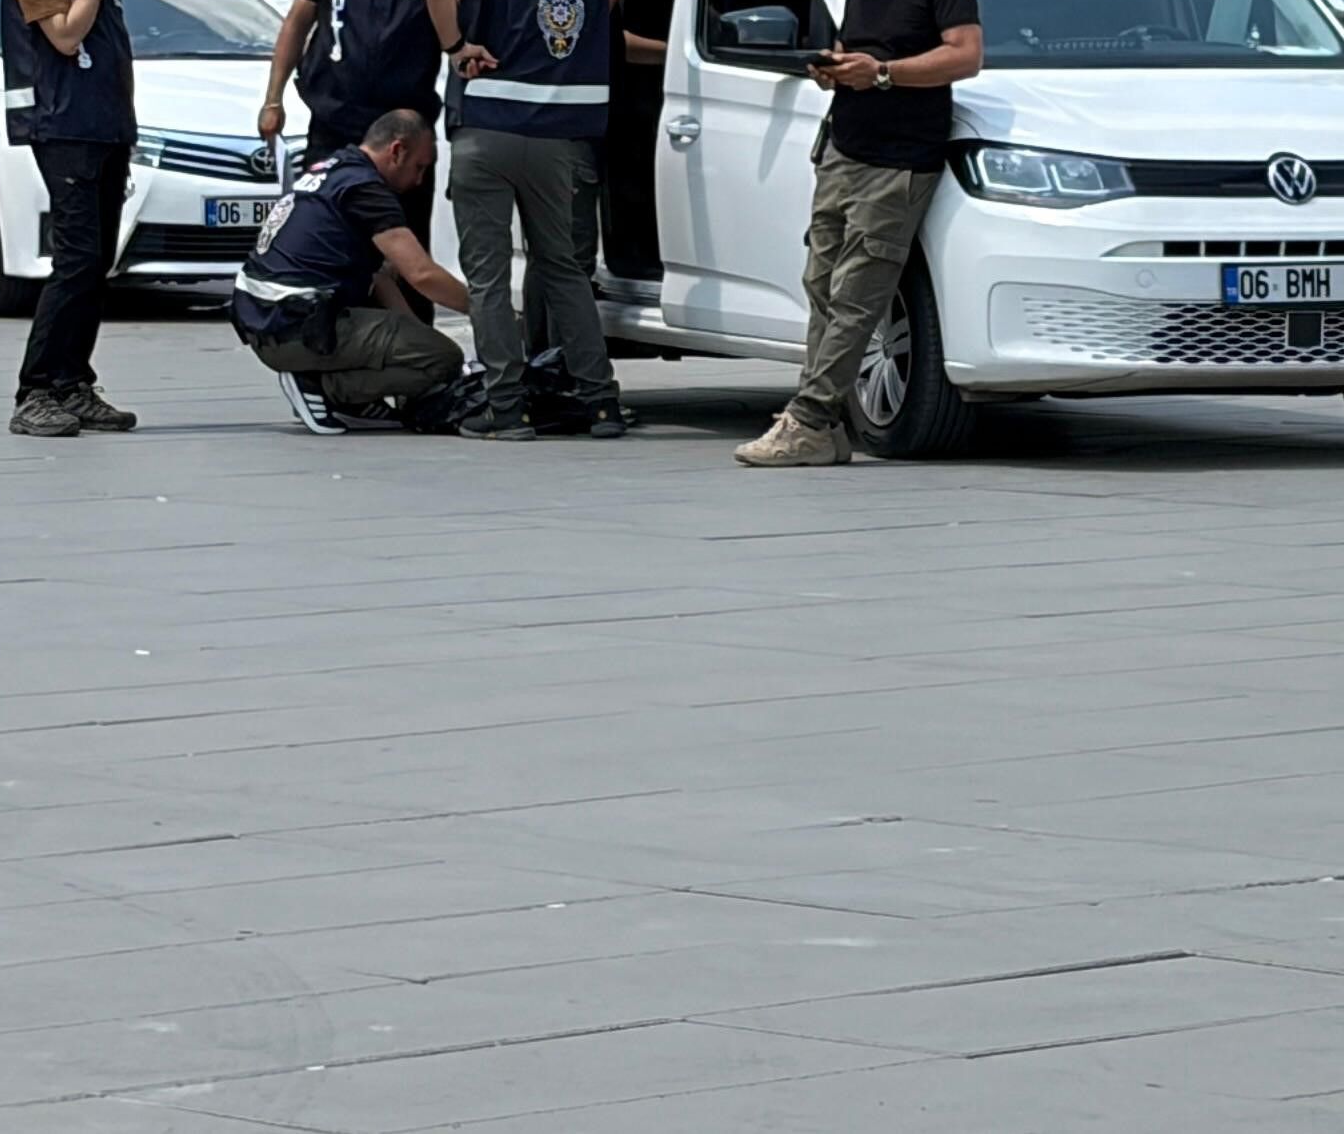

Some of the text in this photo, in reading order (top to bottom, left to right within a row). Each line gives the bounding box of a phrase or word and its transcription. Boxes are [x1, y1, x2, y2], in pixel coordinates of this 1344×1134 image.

[218, 201, 241, 225] 06
[1240, 270, 1270, 300] 06
[1286, 268, 1331, 299] BMH
